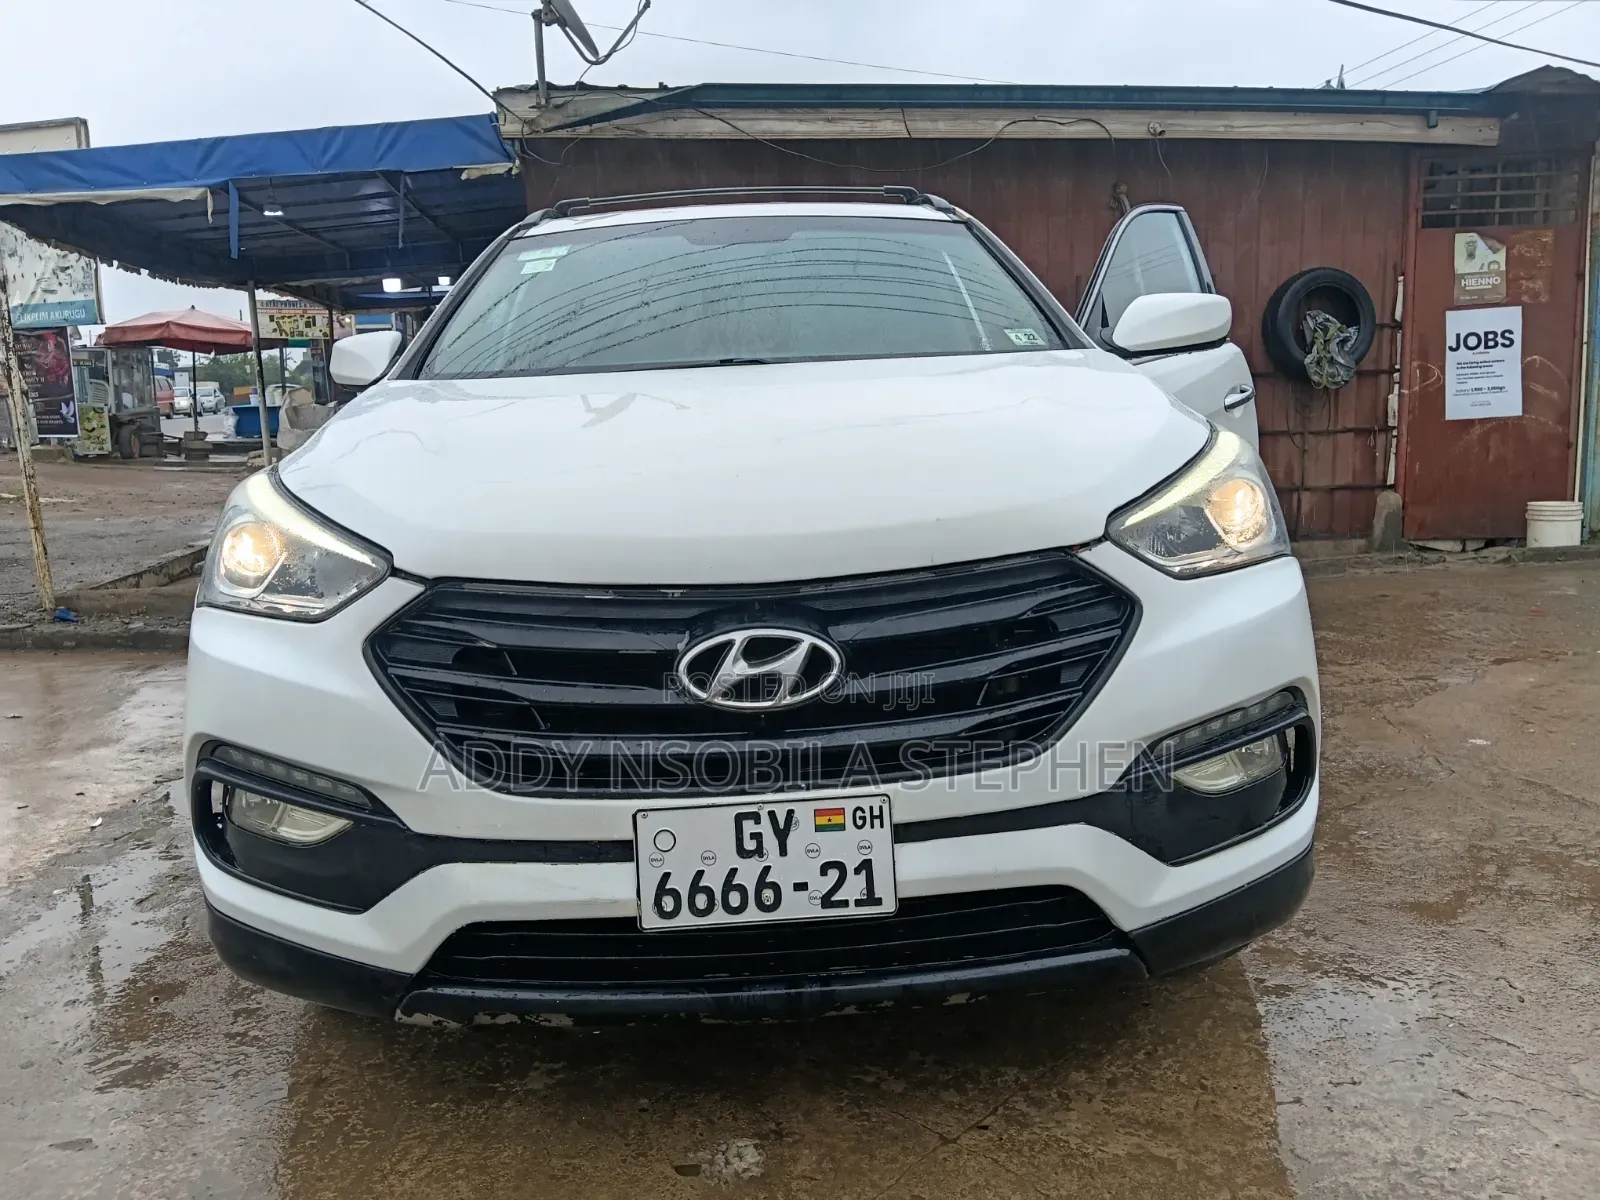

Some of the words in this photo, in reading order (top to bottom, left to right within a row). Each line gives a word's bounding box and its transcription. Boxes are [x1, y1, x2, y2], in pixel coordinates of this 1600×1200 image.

[1461, 276, 1501, 287] HIENNO
[50, 308, 86, 320] AKURUGU
[1448, 329, 1515, 352] JOBS
[734, 808, 795, 859] GY
[852, 805, 884, 830] GH
[653, 858, 883, 920] 6666-21
